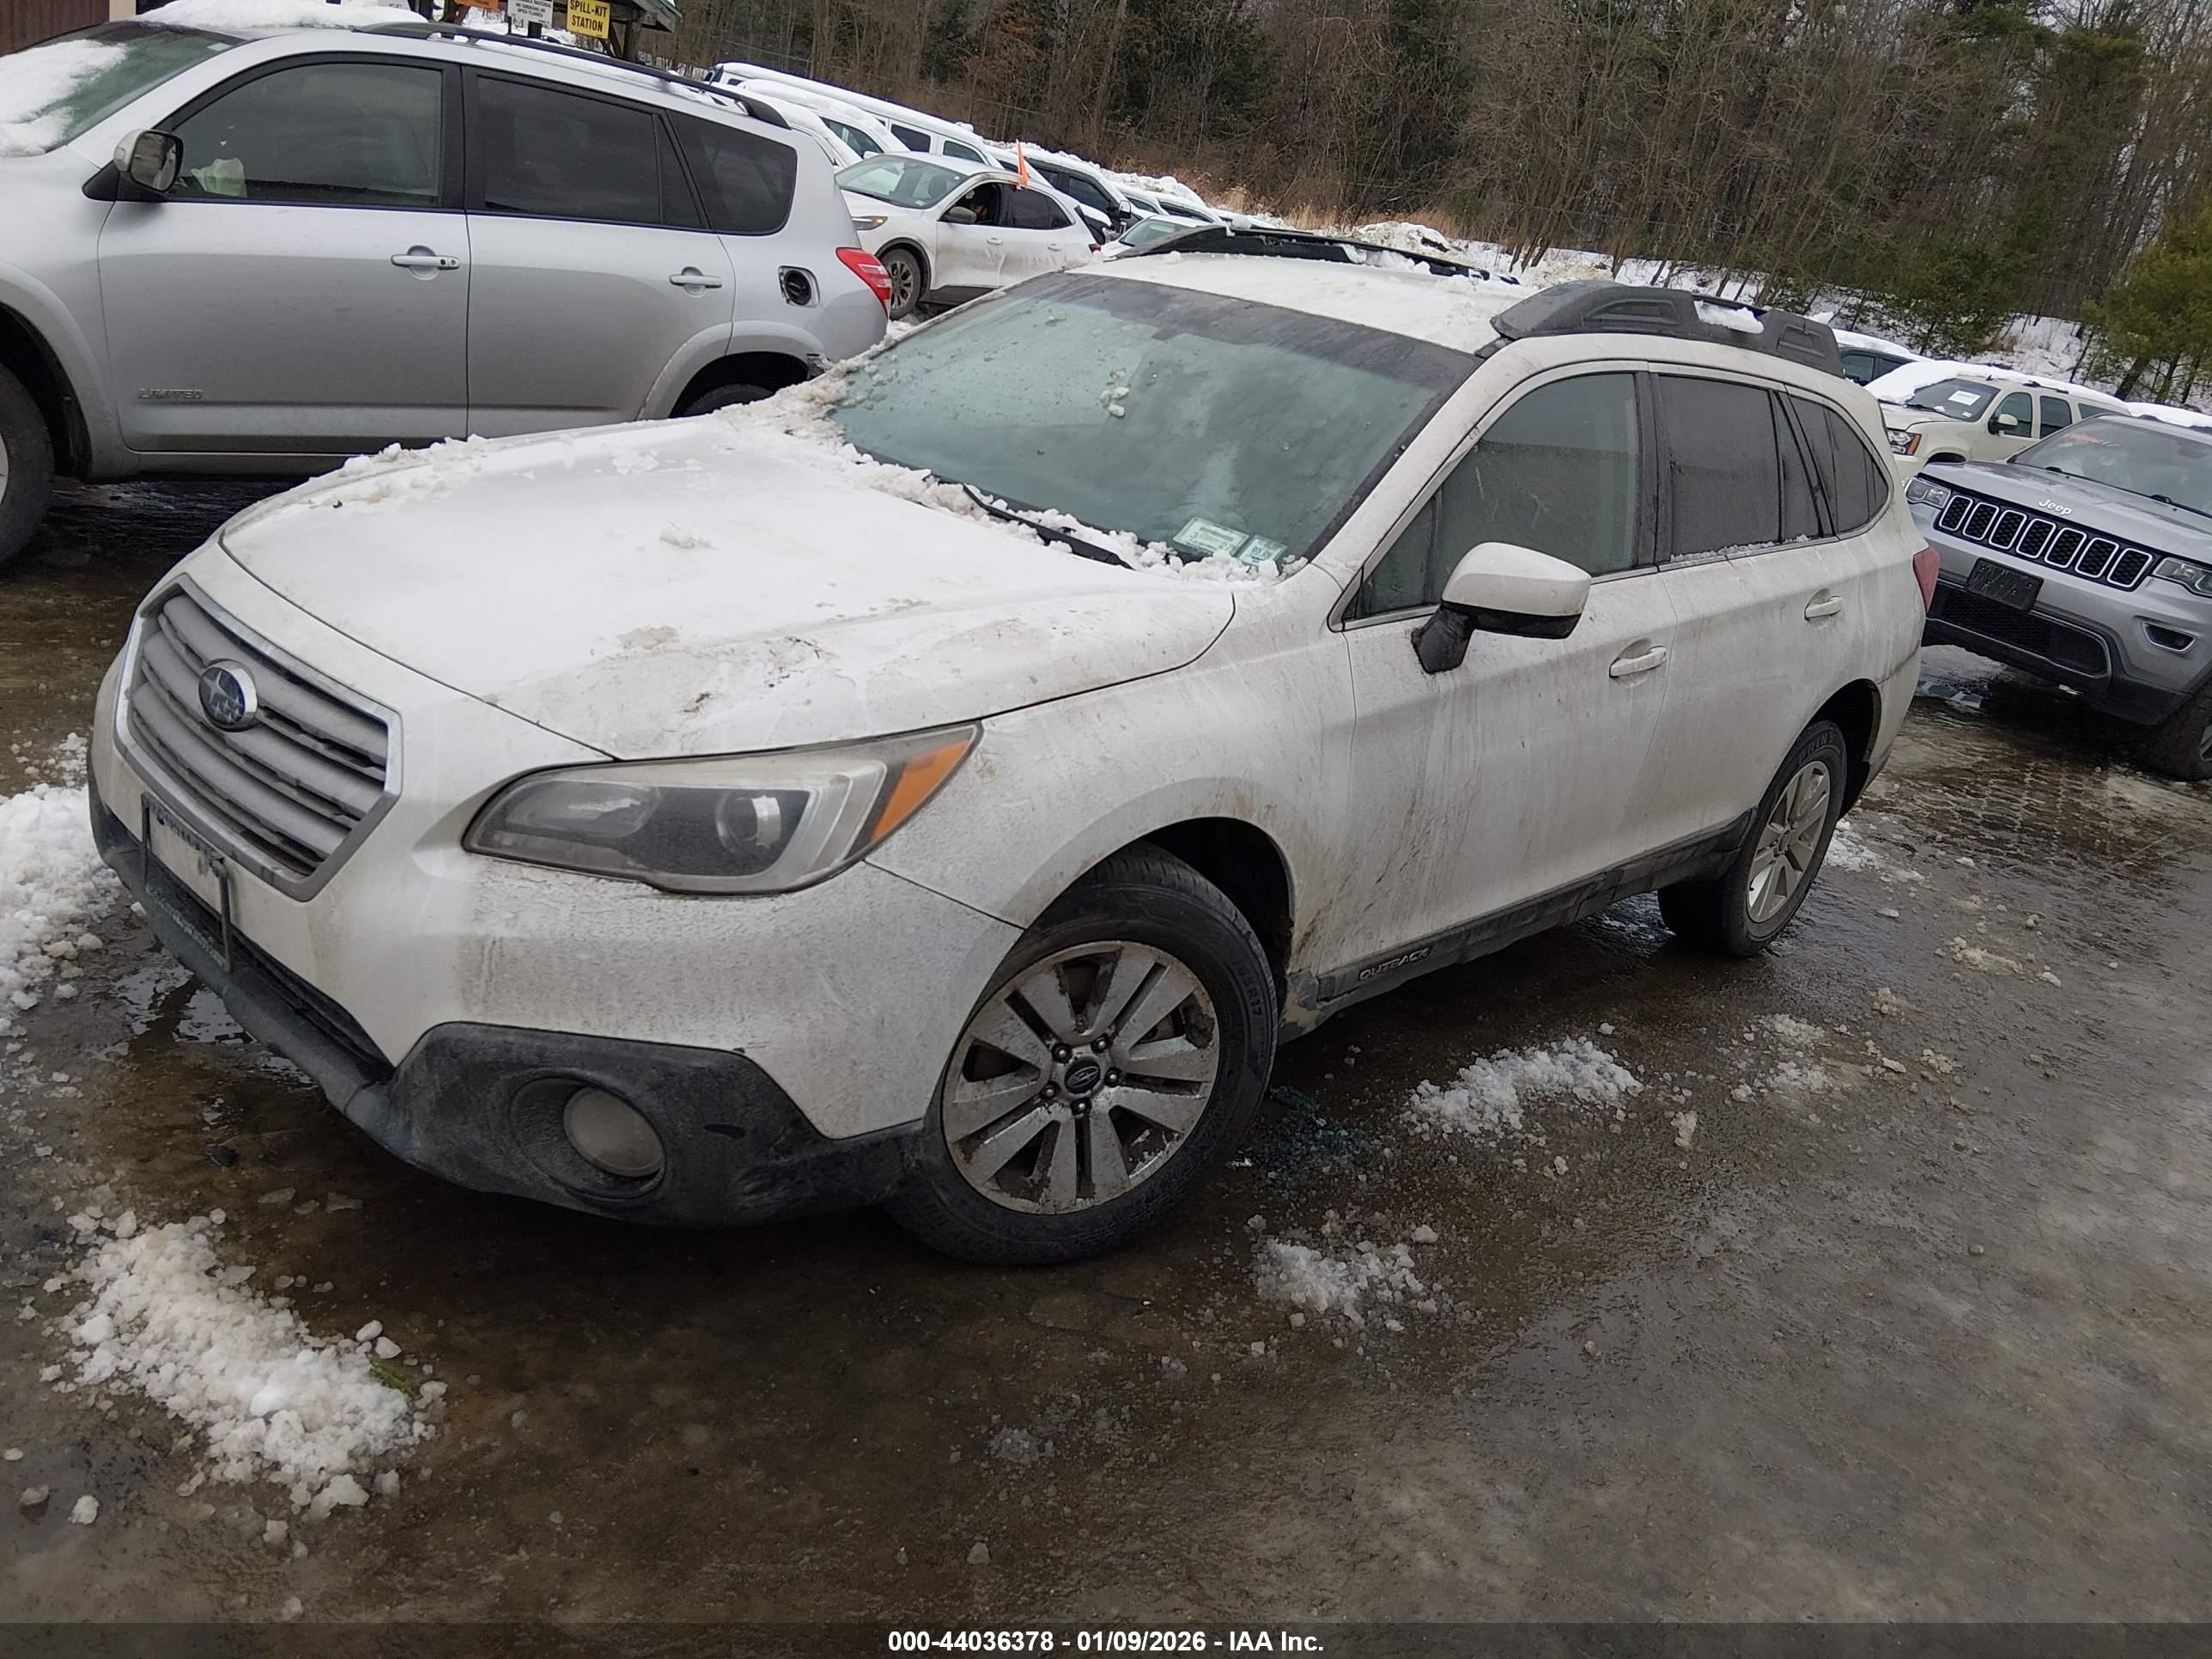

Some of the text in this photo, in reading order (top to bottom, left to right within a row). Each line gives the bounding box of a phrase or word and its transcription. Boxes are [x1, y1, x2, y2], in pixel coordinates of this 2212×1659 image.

[569, 0, 608, 17] SPILL-KIT
[571, 15, 604, 32] STATION
[2039, 499, 2073, 516] Jeep
